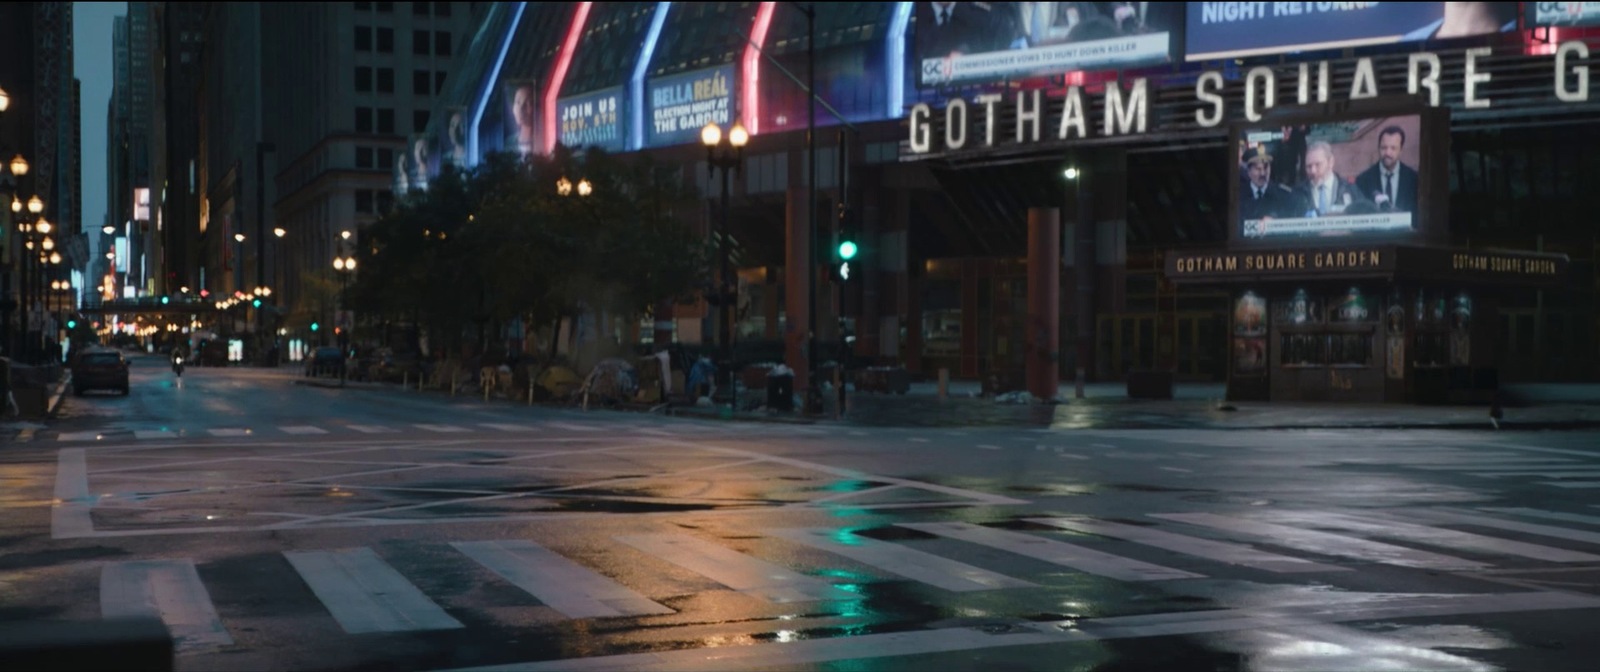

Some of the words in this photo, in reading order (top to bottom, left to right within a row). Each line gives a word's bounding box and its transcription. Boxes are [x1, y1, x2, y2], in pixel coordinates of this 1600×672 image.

[1202, 2, 1265, 24] NIGHT
[954, 57, 1014, 70] COMMISSIONER
[1017, 53, 1040, 64] VOWS
[1042, 52, 1053, 61] TO
[1054, 49, 1078, 60] HUNT
[1080, 46, 1106, 57] DOWN
[1108, 42, 1137, 54] KILLER
[654, 83, 693, 109] BELLA
[562, 102, 592, 122] JOIN
[599, 96, 616, 113] US
[654, 104, 691, 121] ELECTION
[692, 99, 716, 114] NIGHT
[717, 97, 729, 110] AT
[909, 77, 1147, 154] GOTHAM
[655, 117, 678, 134] THE
[679, 110, 728, 130] GARDEN
[1176, 256, 1237, 272] GOTHAM
[1246, 253, 1305, 270] SQUARE
[1453, 253, 1487, 270] GOTHAM
[1491, 256, 1521, 272] SQUARE
[1525, 258, 1556, 274] GARDEN
